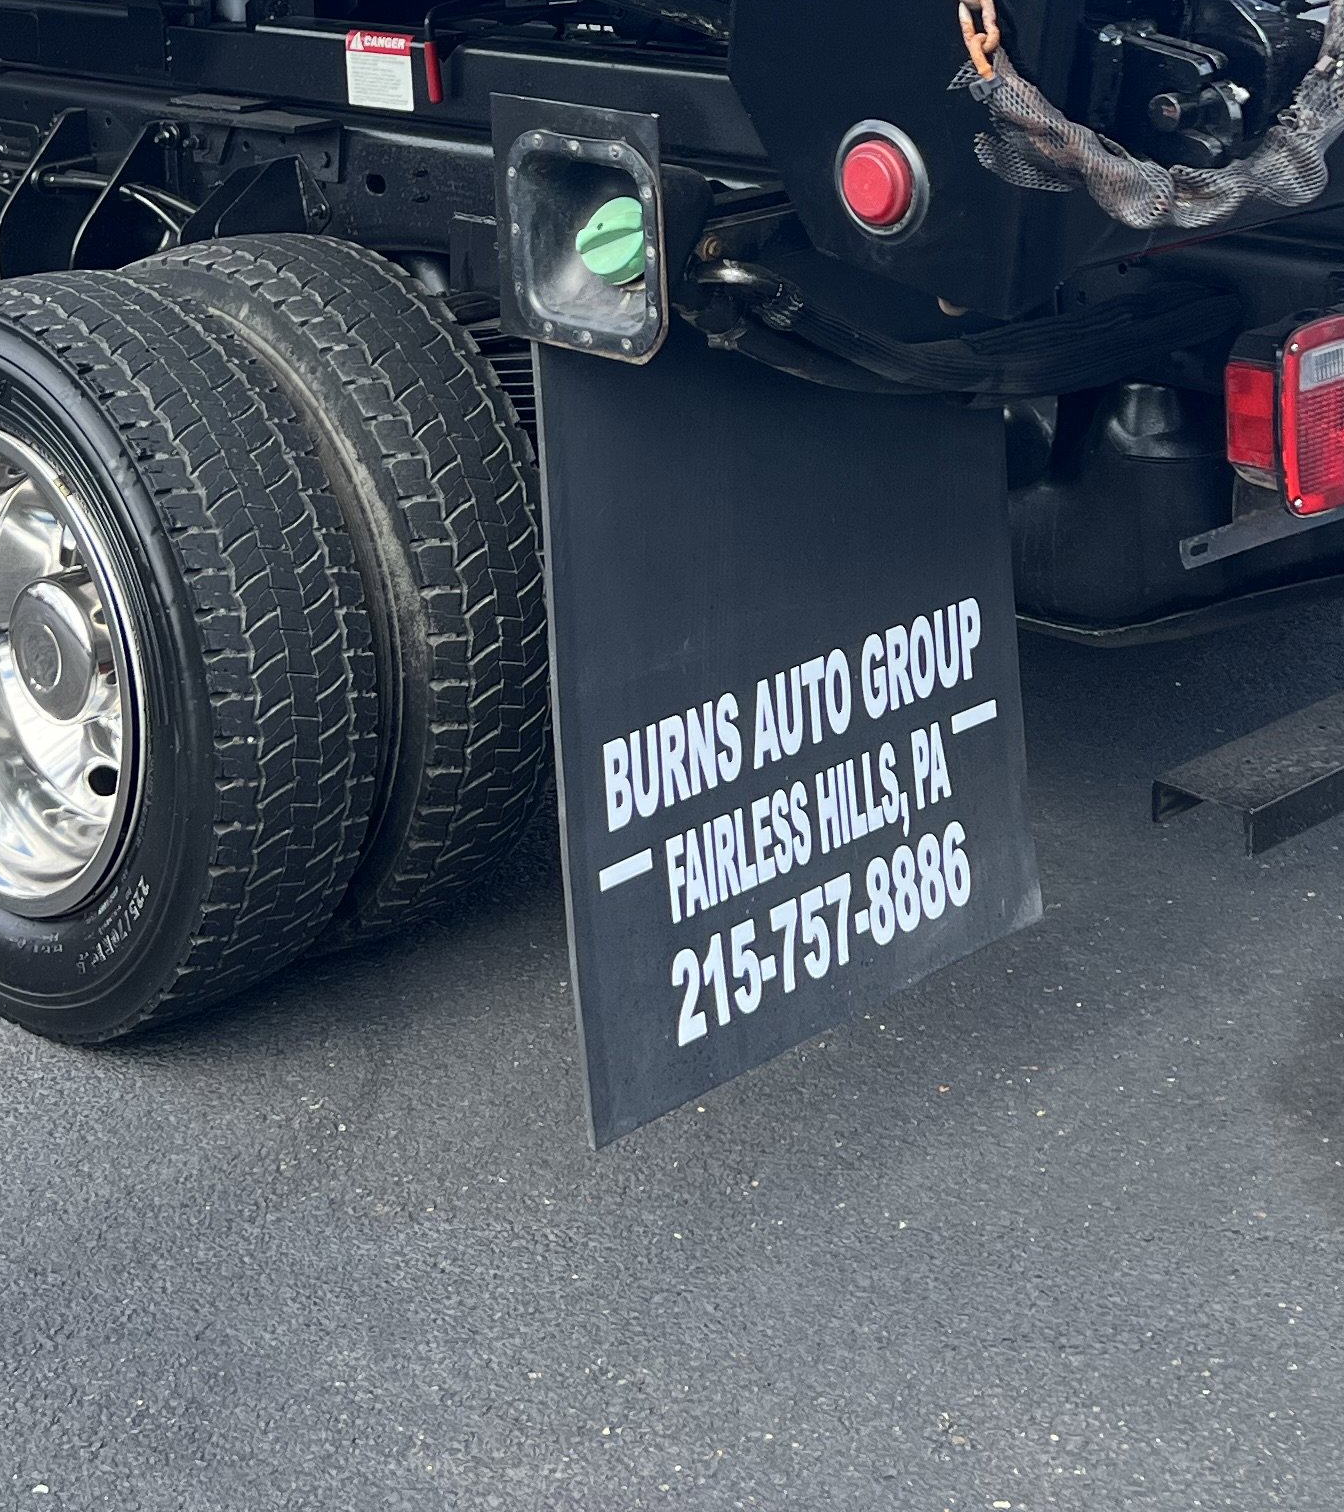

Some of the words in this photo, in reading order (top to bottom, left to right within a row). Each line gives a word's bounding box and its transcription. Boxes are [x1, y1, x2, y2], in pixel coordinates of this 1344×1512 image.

[363, 35, 406, 50] DANGER
[602, 692, 742, 833] BURNS
[753, 647, 852, 771] AUTO
[861, 596, 982, 720] GROUP
[664, 780, 812, 925] FAIRLESS
[815, 742, 910, 855] HILLS,
[912, 721, 952, 810] PA
[671, 820, 972, 1047] 215-757-8886
